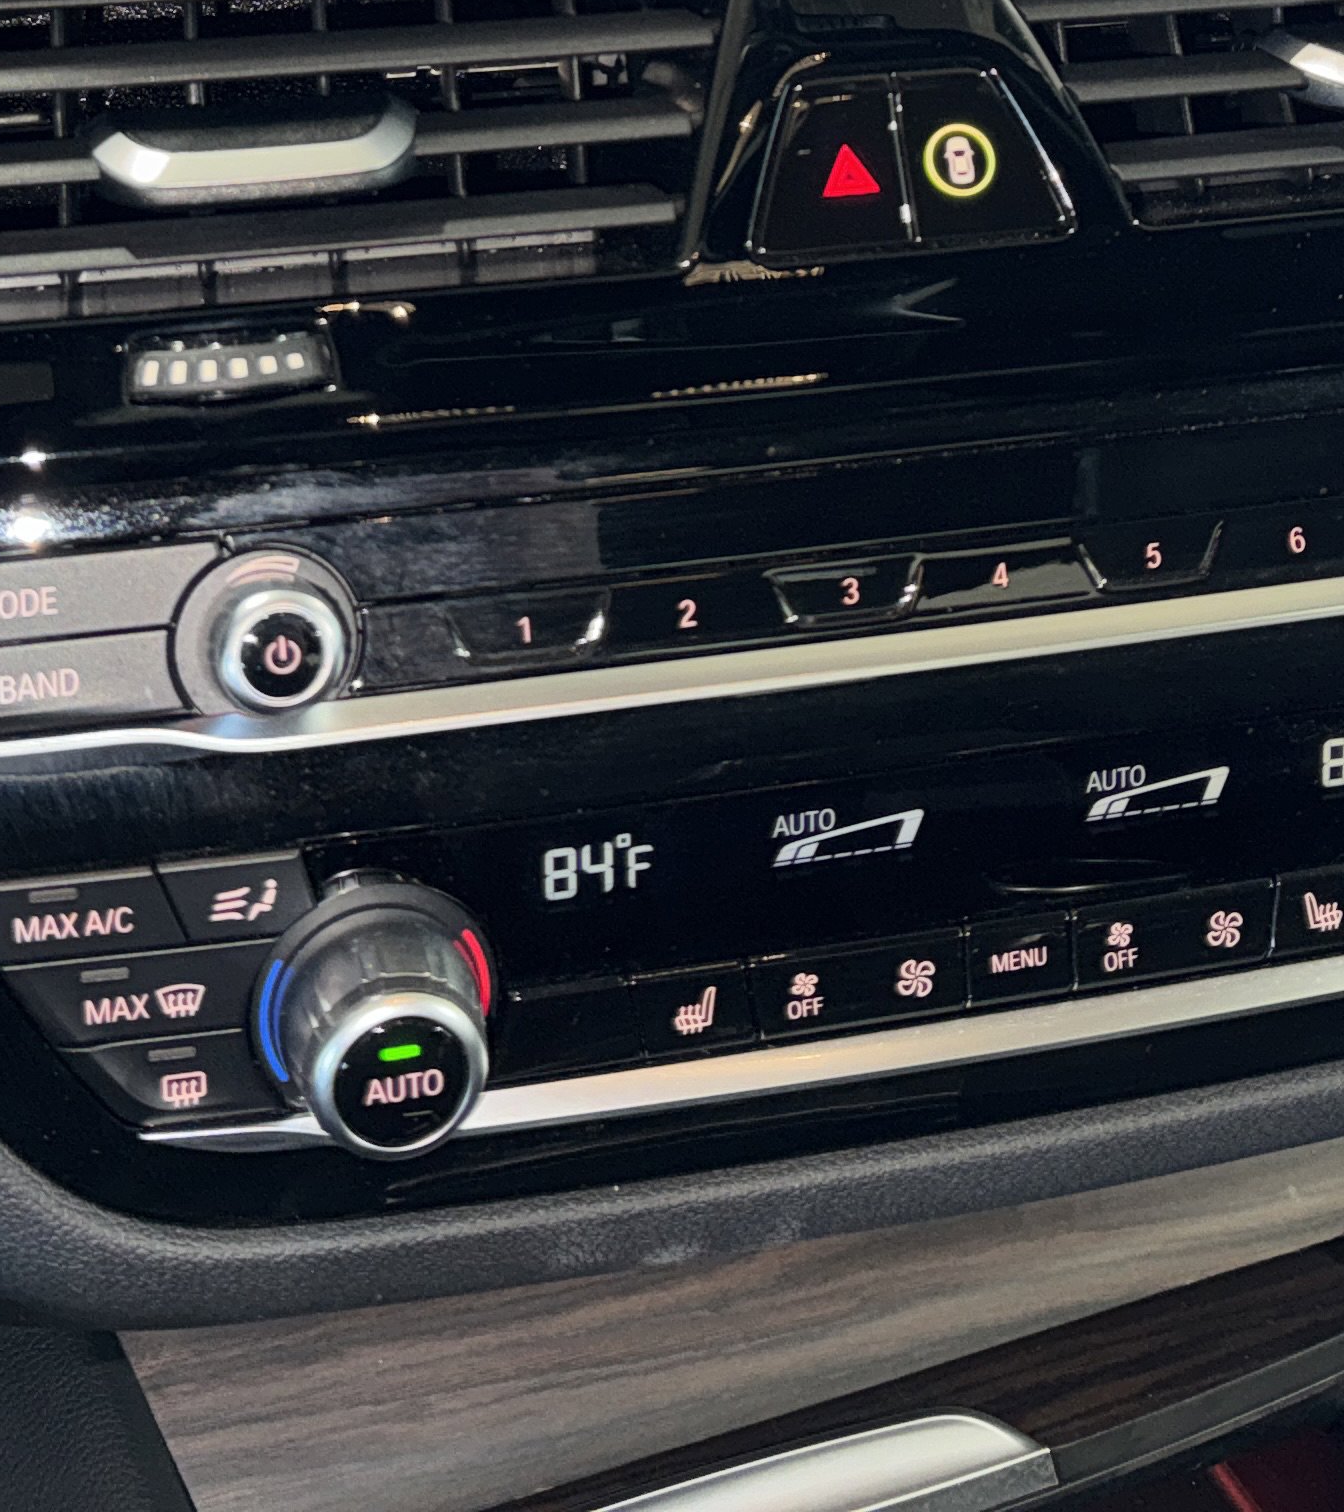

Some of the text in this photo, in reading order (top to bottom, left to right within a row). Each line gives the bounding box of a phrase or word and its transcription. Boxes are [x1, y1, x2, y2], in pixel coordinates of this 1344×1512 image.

[1288, 525, 1306, 555] 6
[1145, 541, 1163, 570] 5
[991, 561, 1011, 589] 4
[841, 576, 861, 606] 3
[677, 598, 699, 629] 2
[516, 615, 533, 644] 1
[1085, 764, 1146, 794] AUTO
[772, 807, 836, 839] AUTO
[12, 906, 135, 944] MAX A/C
[990, 945, 1049, 975] MENU
[1102, 946, 1139, 973] OFF
[83, 992, 151, 1026] MAX
[785, 995, 825, 1021] OFF
[364, 1067, 445, 1107] AUTO
